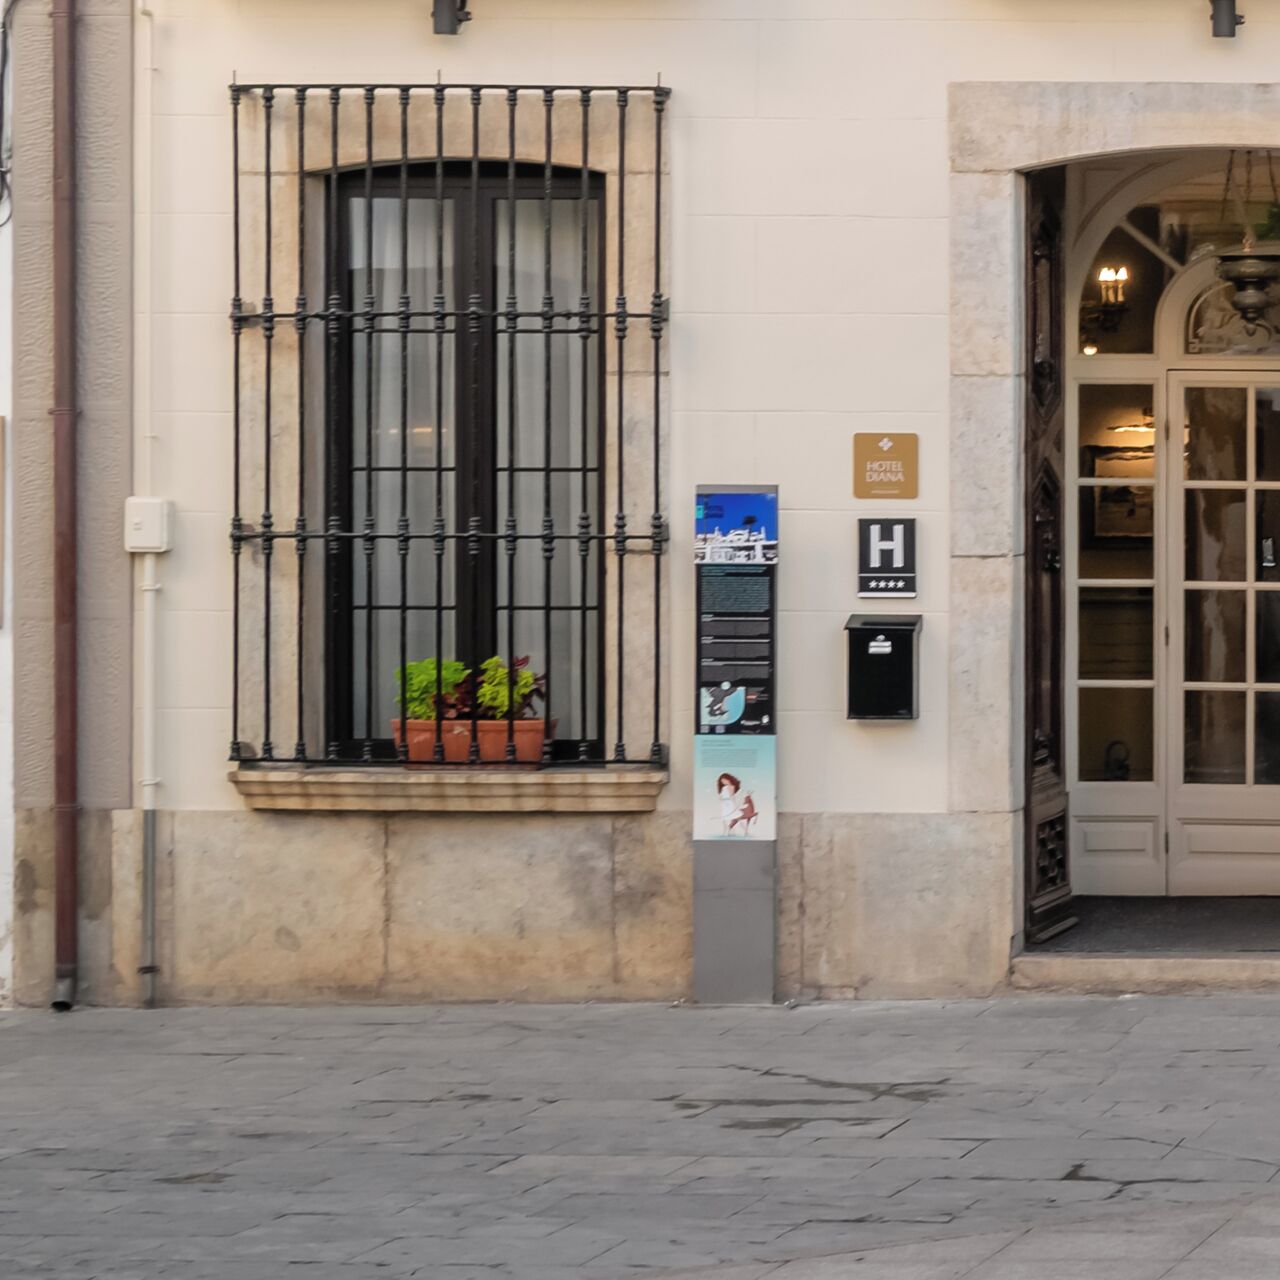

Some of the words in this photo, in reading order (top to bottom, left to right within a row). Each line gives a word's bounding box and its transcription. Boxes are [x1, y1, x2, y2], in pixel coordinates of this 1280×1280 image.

[866, 460, 904, 471] HOTEL
[865, 471, 905, 482] DIANA
[869, 524, 905, 569] H
